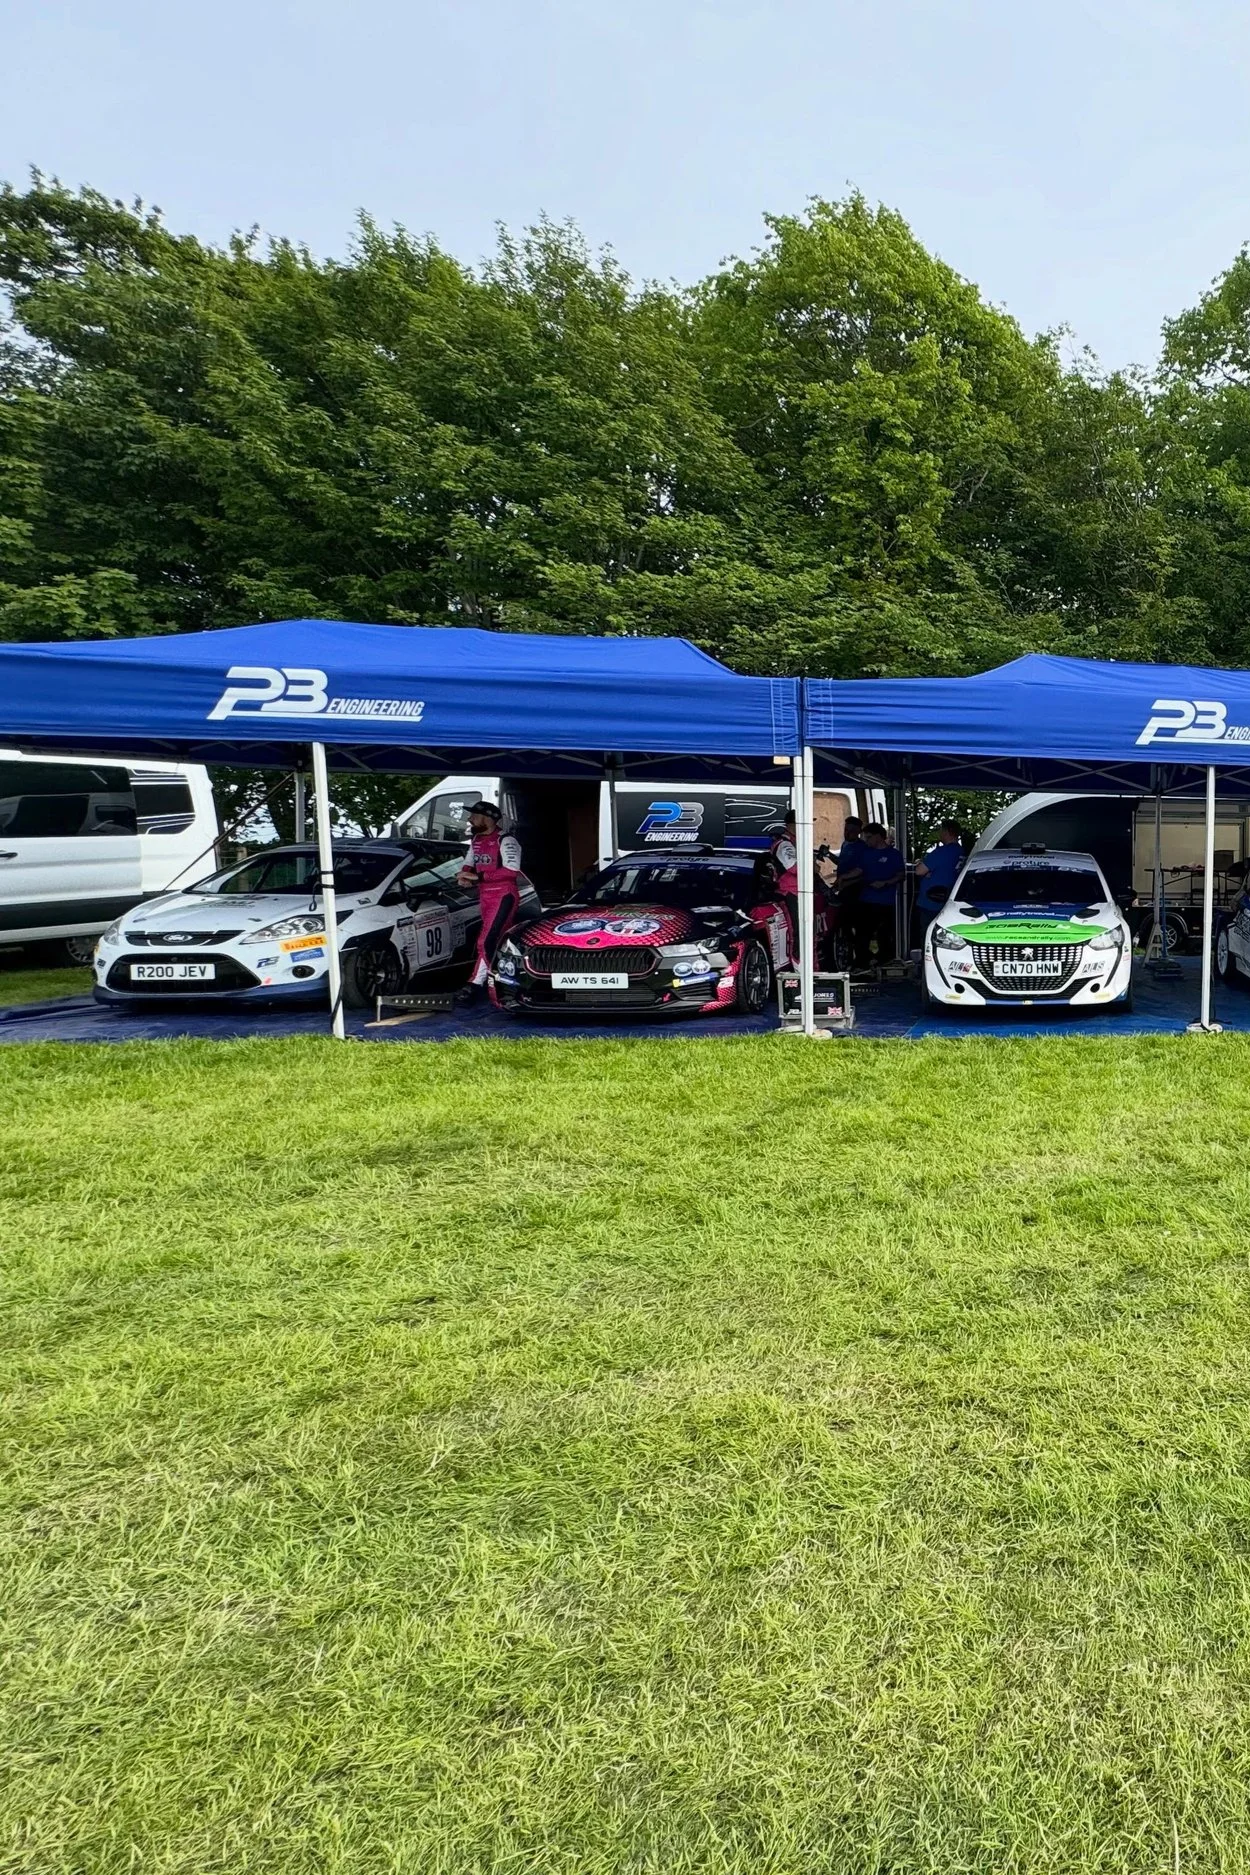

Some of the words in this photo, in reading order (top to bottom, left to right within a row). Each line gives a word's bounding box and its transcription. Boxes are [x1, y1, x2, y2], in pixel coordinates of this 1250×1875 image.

[325, 698, 426, 716] ENGINEERING
[644, 831, 700, 842] ENGINEERING
[426, 926, 443, 958] 98
[137, 966, 174, 978] R200
[179, 965, 207, 978] JEV
[1002, 963, 1033, 975] CN70
[1036, 963, 1060, 975] HNW
[560, 976, 580, 985] AW
[582, 976, 598, 985] TS
[601, 976, 619, 985] 641
